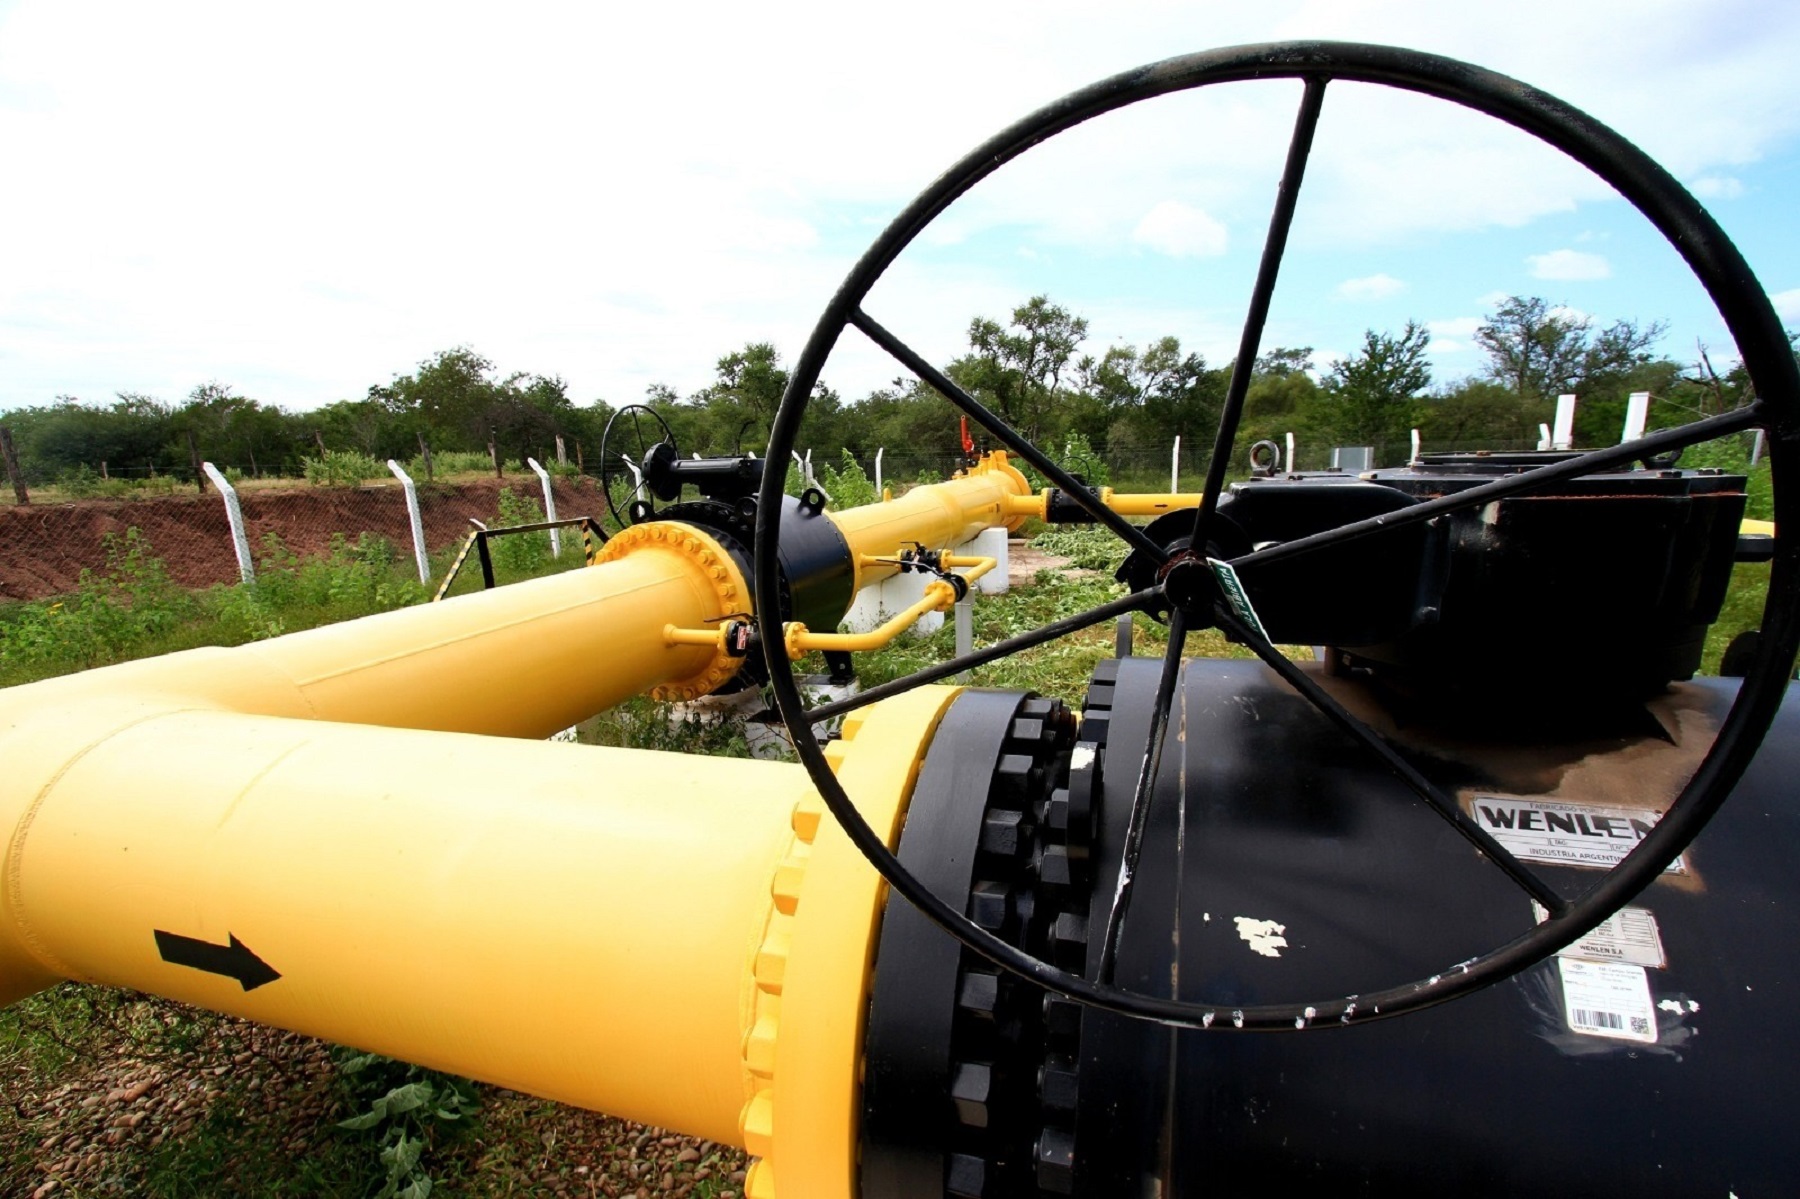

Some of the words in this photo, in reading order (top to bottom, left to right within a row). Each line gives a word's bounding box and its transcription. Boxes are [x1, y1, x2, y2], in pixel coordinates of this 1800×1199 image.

[1219, 567, 1246, 608] ABIERTA
[1529, 802, 1577, 812] FABRICADO
[1529, 847, 1577, 858] INDUSTRIA
[1579, 853, 1624, 862] ARGENTIN
[1579, 945, 1610, 954] WENLEN
